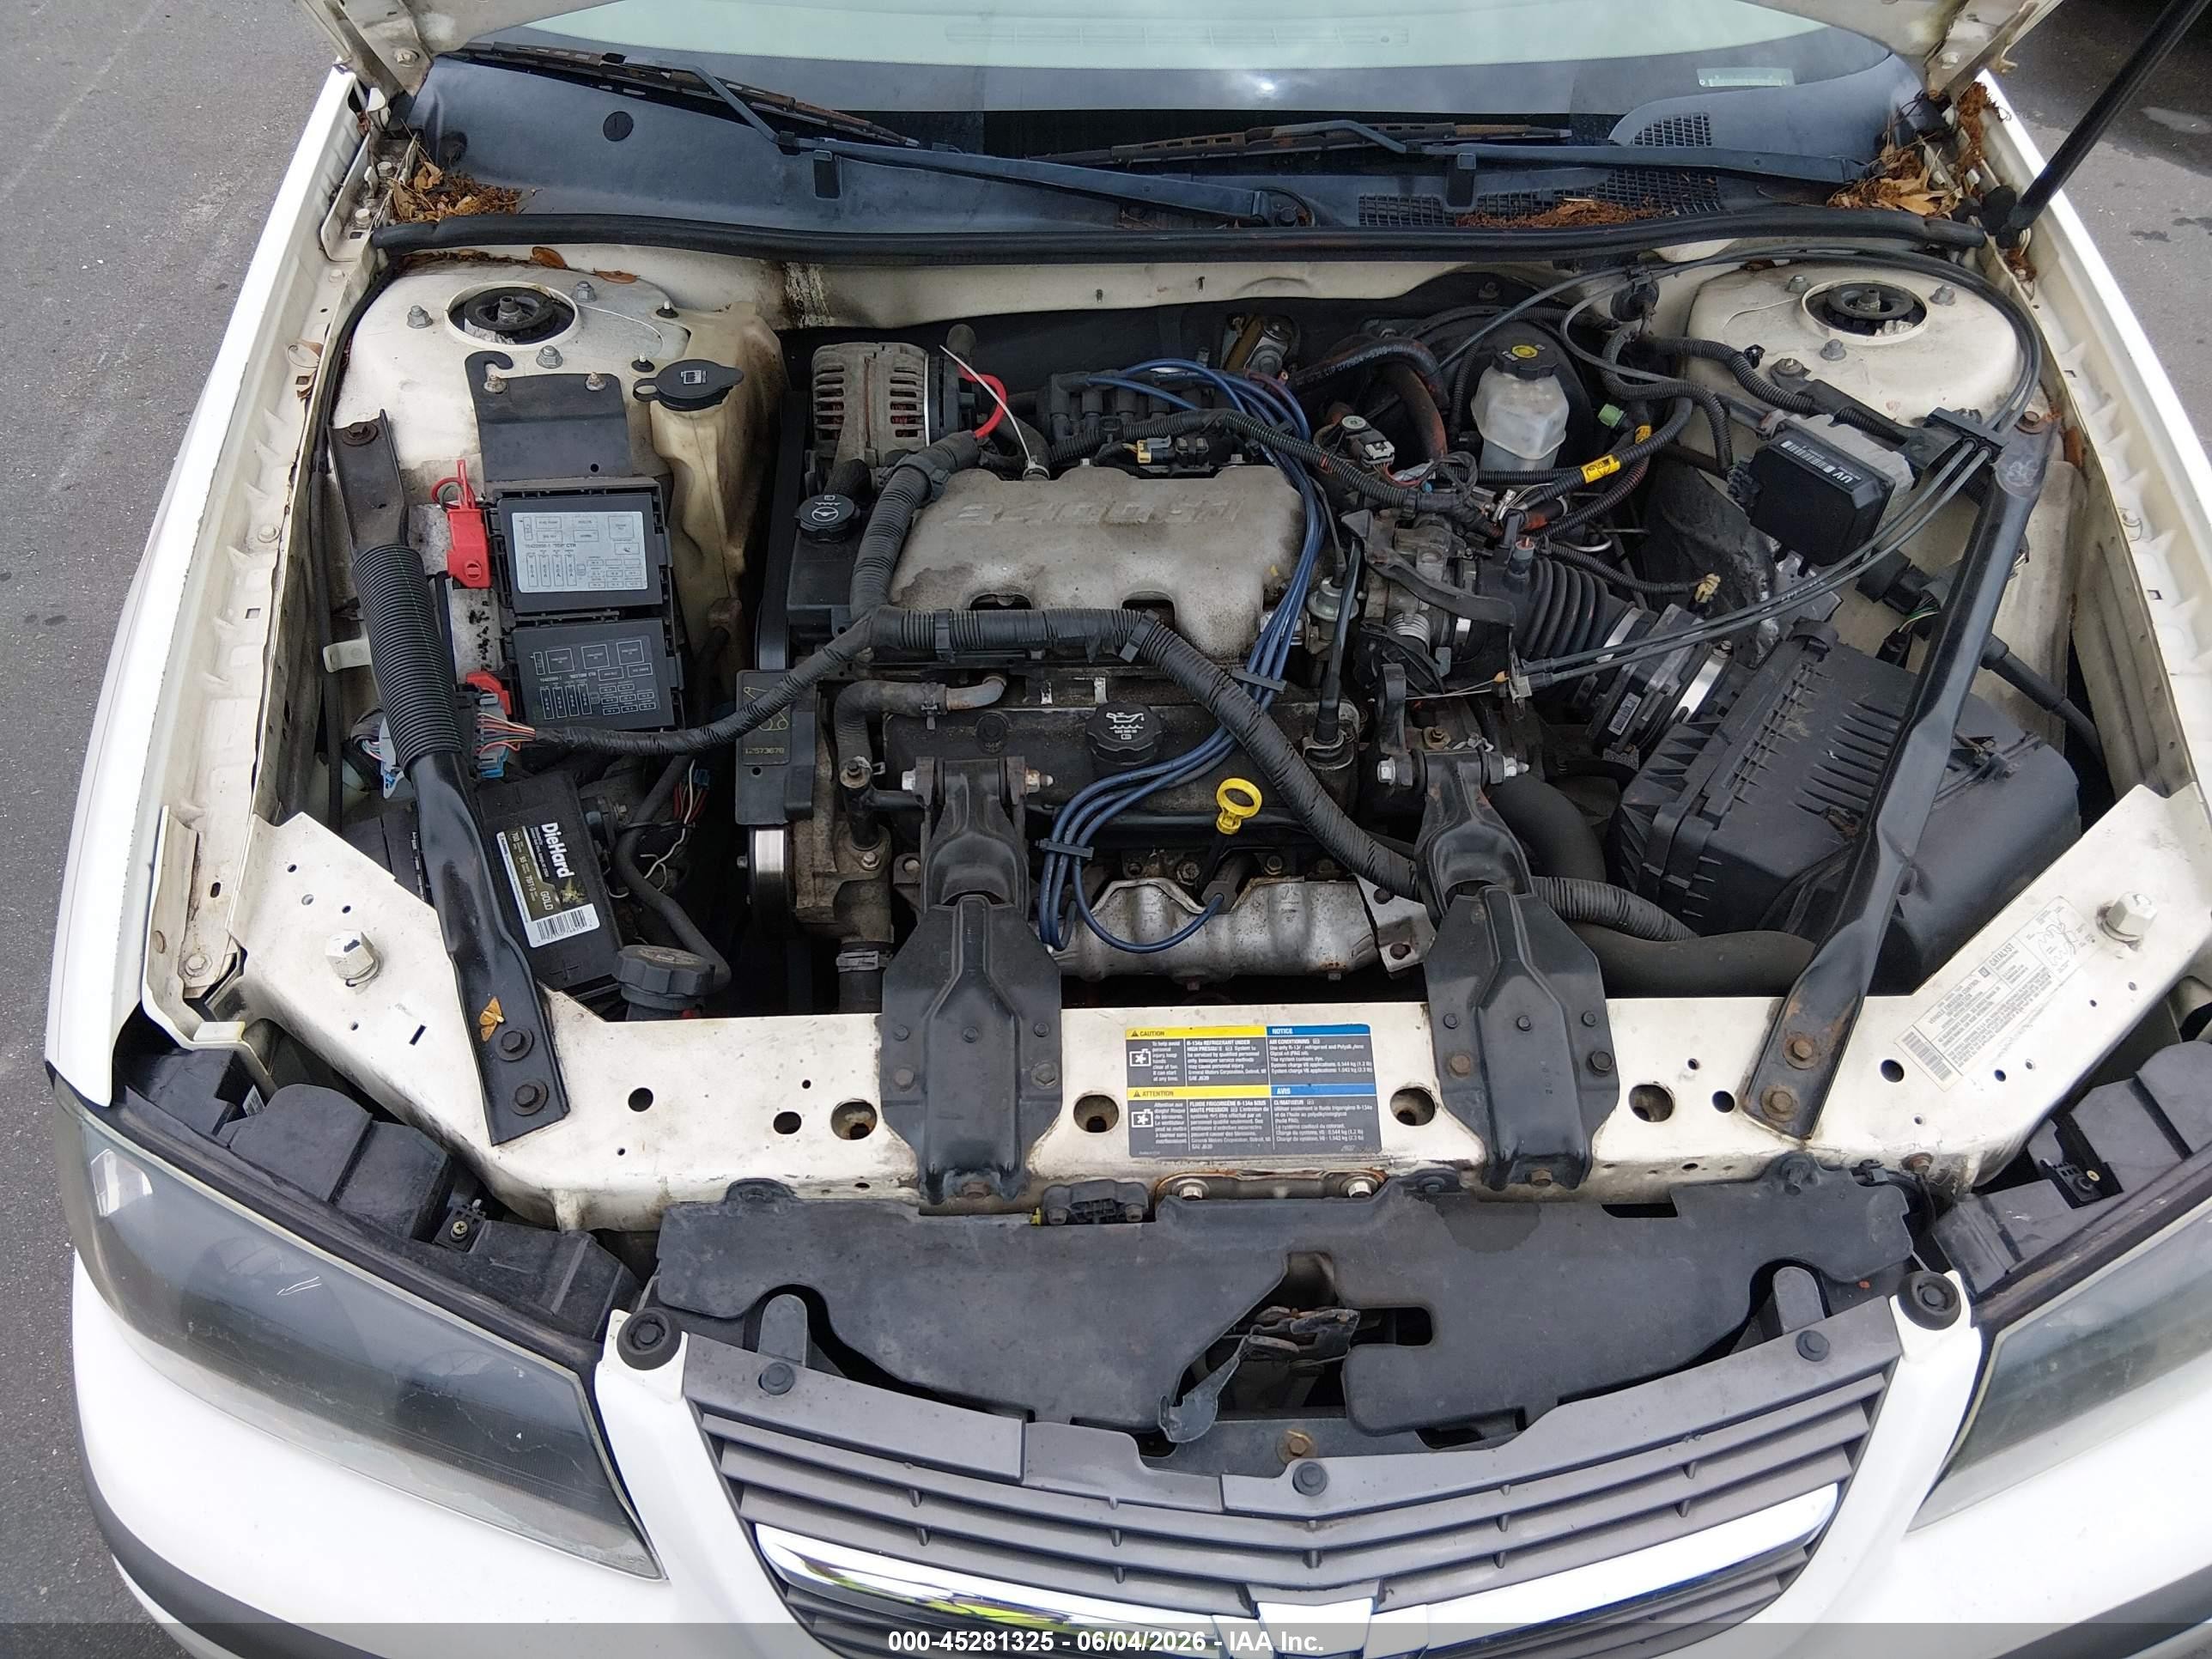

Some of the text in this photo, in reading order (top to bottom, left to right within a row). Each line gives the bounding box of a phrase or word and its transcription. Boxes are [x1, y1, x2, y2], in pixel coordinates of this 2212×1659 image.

[541, 822, 575, 878] DieHard
[540, 890, 555, 912] GOLD
[1988, 942, 2014, 967] CATALYST
